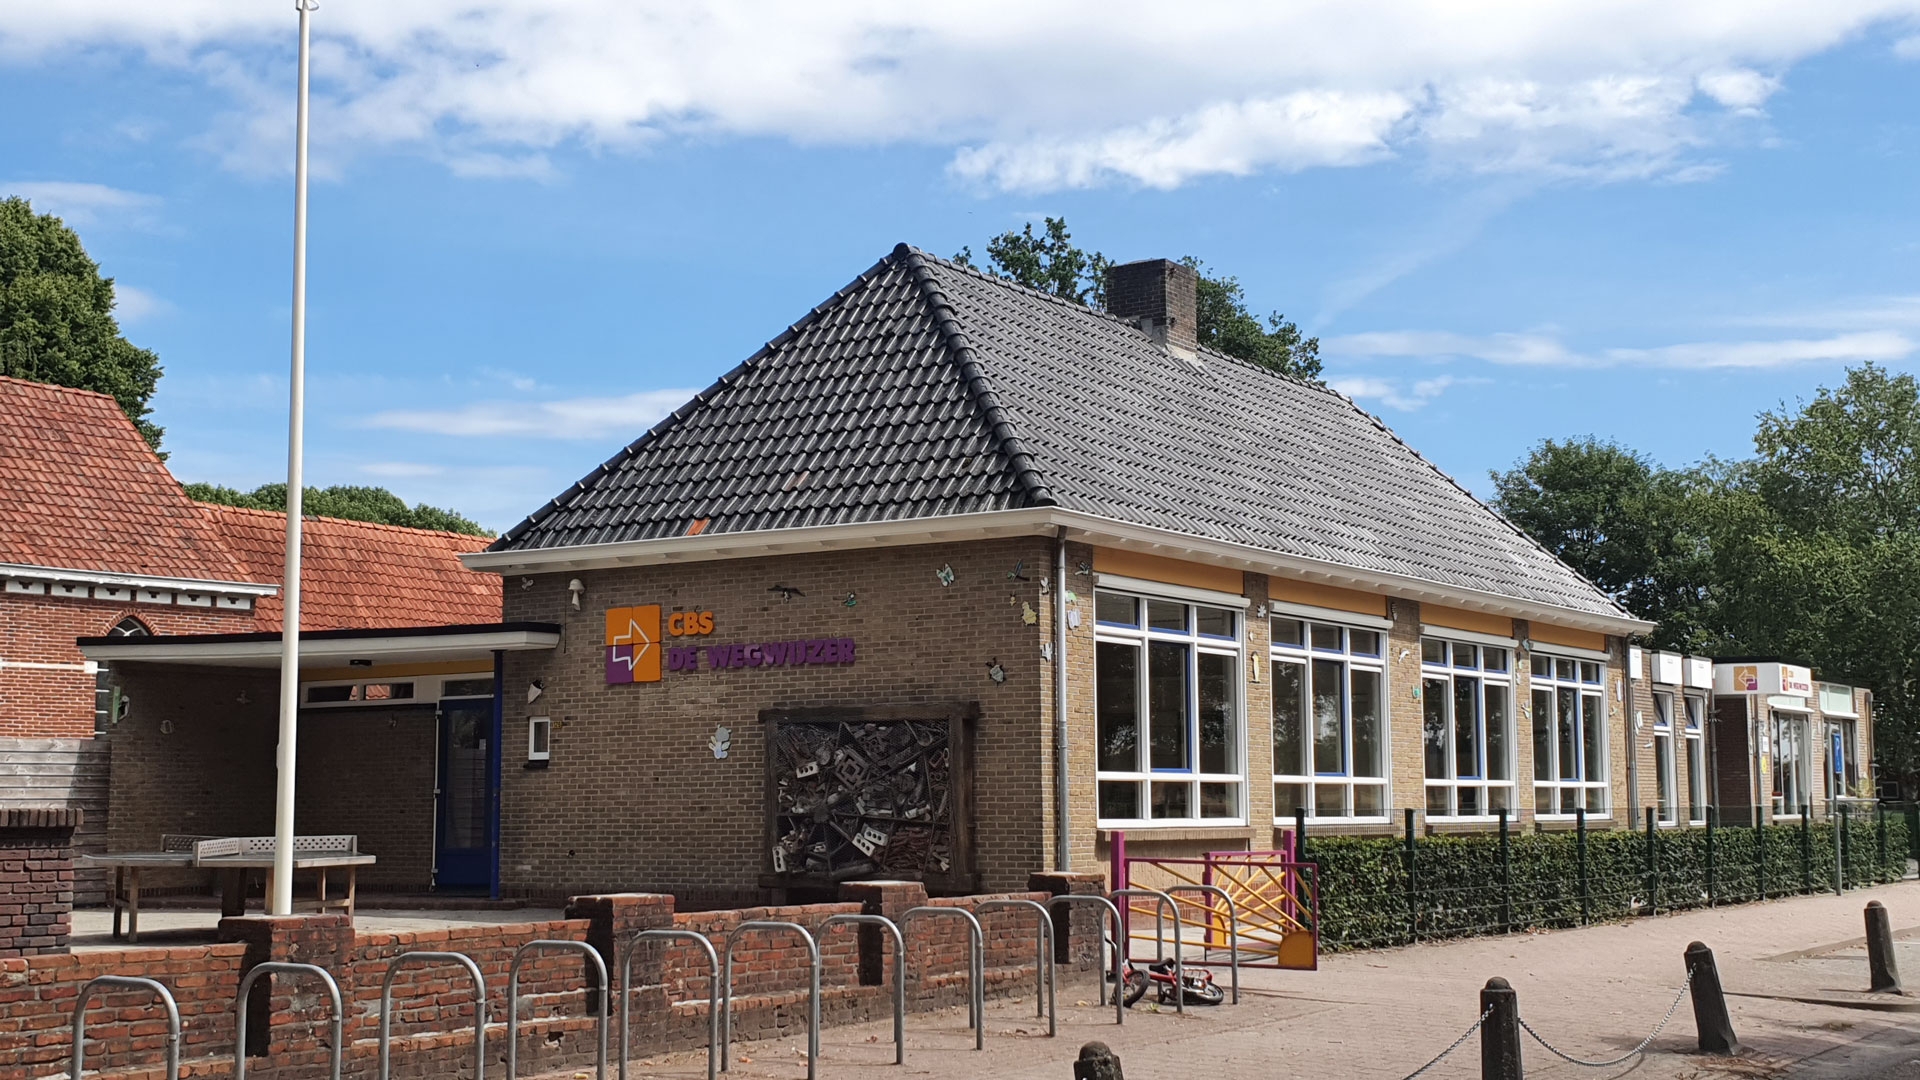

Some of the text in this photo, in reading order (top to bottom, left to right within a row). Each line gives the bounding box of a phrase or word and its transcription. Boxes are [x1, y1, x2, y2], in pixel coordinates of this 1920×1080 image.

[668, 611, 714, 636] CBS
[668, 638, 855, 670] DE WEGWIJZER
